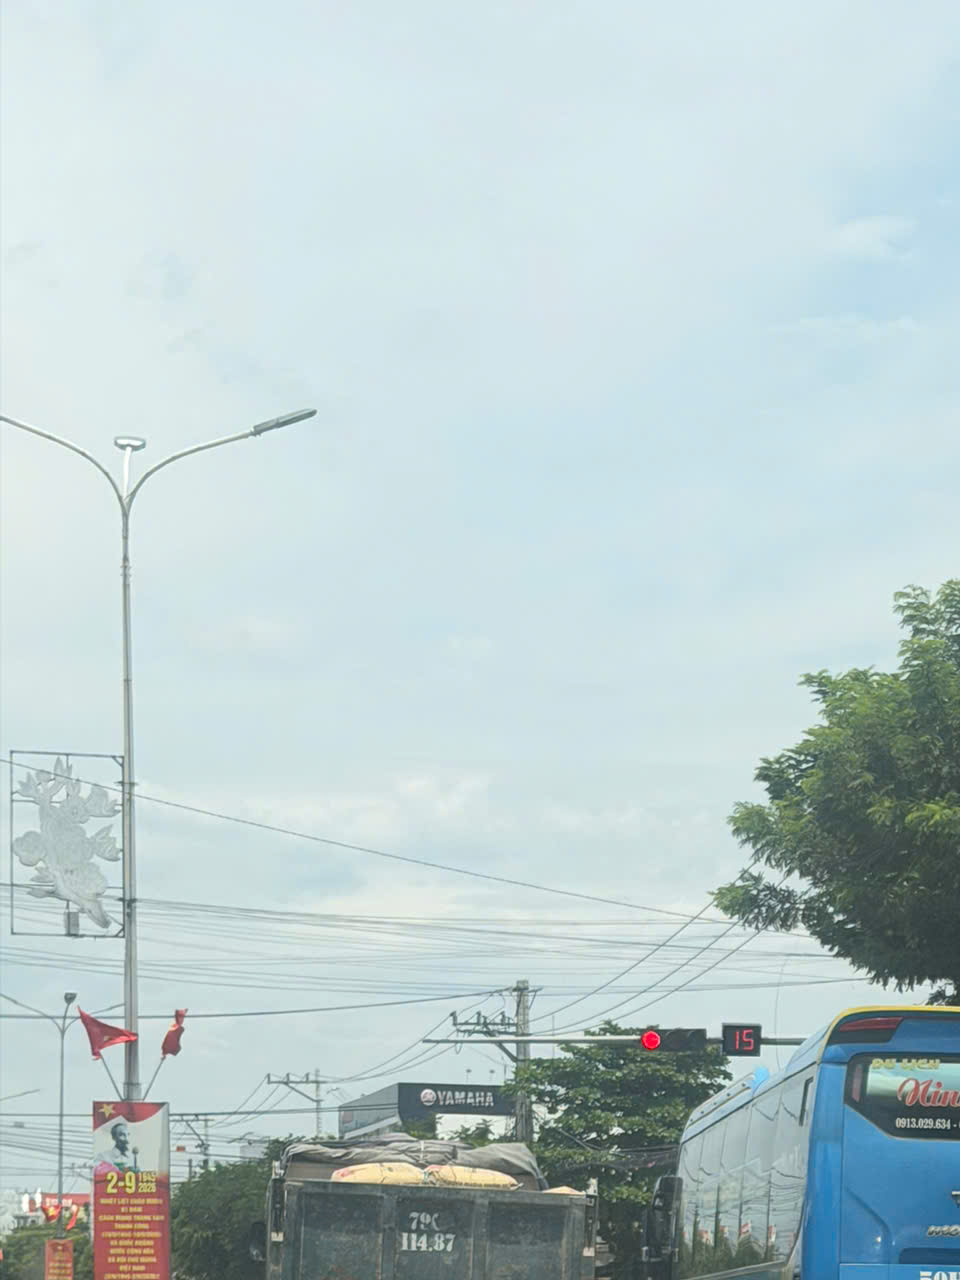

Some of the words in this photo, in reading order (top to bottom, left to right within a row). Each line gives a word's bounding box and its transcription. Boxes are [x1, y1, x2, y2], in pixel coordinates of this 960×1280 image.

[735, 1029, 754, 1051] 15
[436, 1090, 495, 1107] YAMAHA
[106, 1171, 136, 1193] 2-9
[401, 1232, 456, 1252] 114.87
